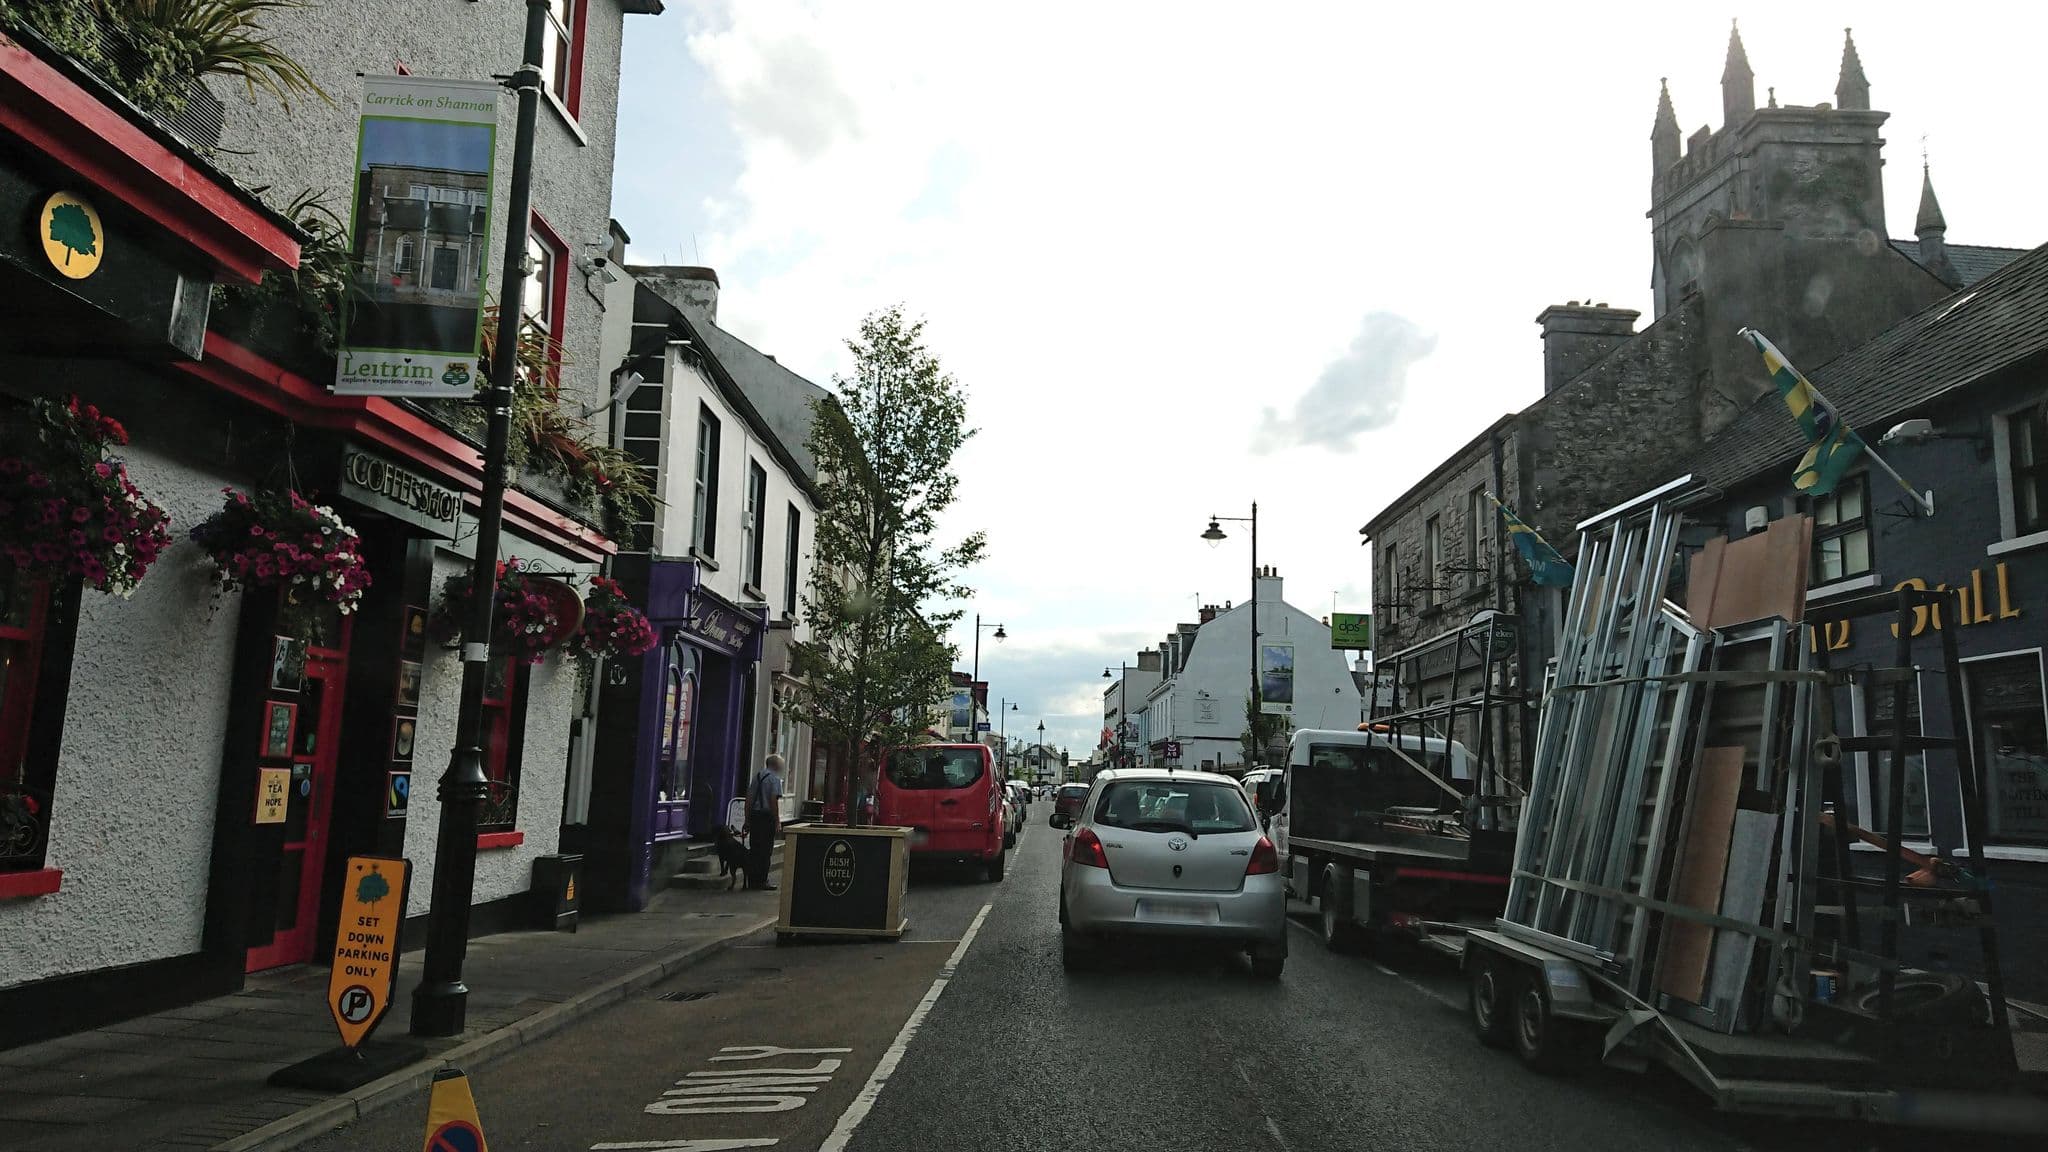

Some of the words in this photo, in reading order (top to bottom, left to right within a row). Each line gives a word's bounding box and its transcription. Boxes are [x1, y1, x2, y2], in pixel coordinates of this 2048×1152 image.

[366, 92, 414, 107] Carrick
[417, 98, 433, 108] on
[436, 96, 493, 112] Shannon
[343, 357, 433, 378] Leitrim
[342, 376, 366, 384] explore
[372, 377, 408, 385] experience
[1338, 617, 1360, 634] dps
[267, 784, 283, 793] TEA
[829, 857, 850, 867] BUSH
[825, 869, 851, 878] HOTEL
[357, 916, 380, 928] SET
[348, 932, 384, 945] DOWN
[337, 948, 390, 962] PARKING
[345, 966, 377, 978] ONLY
[644, 1045, 852, 1115] ONLY
